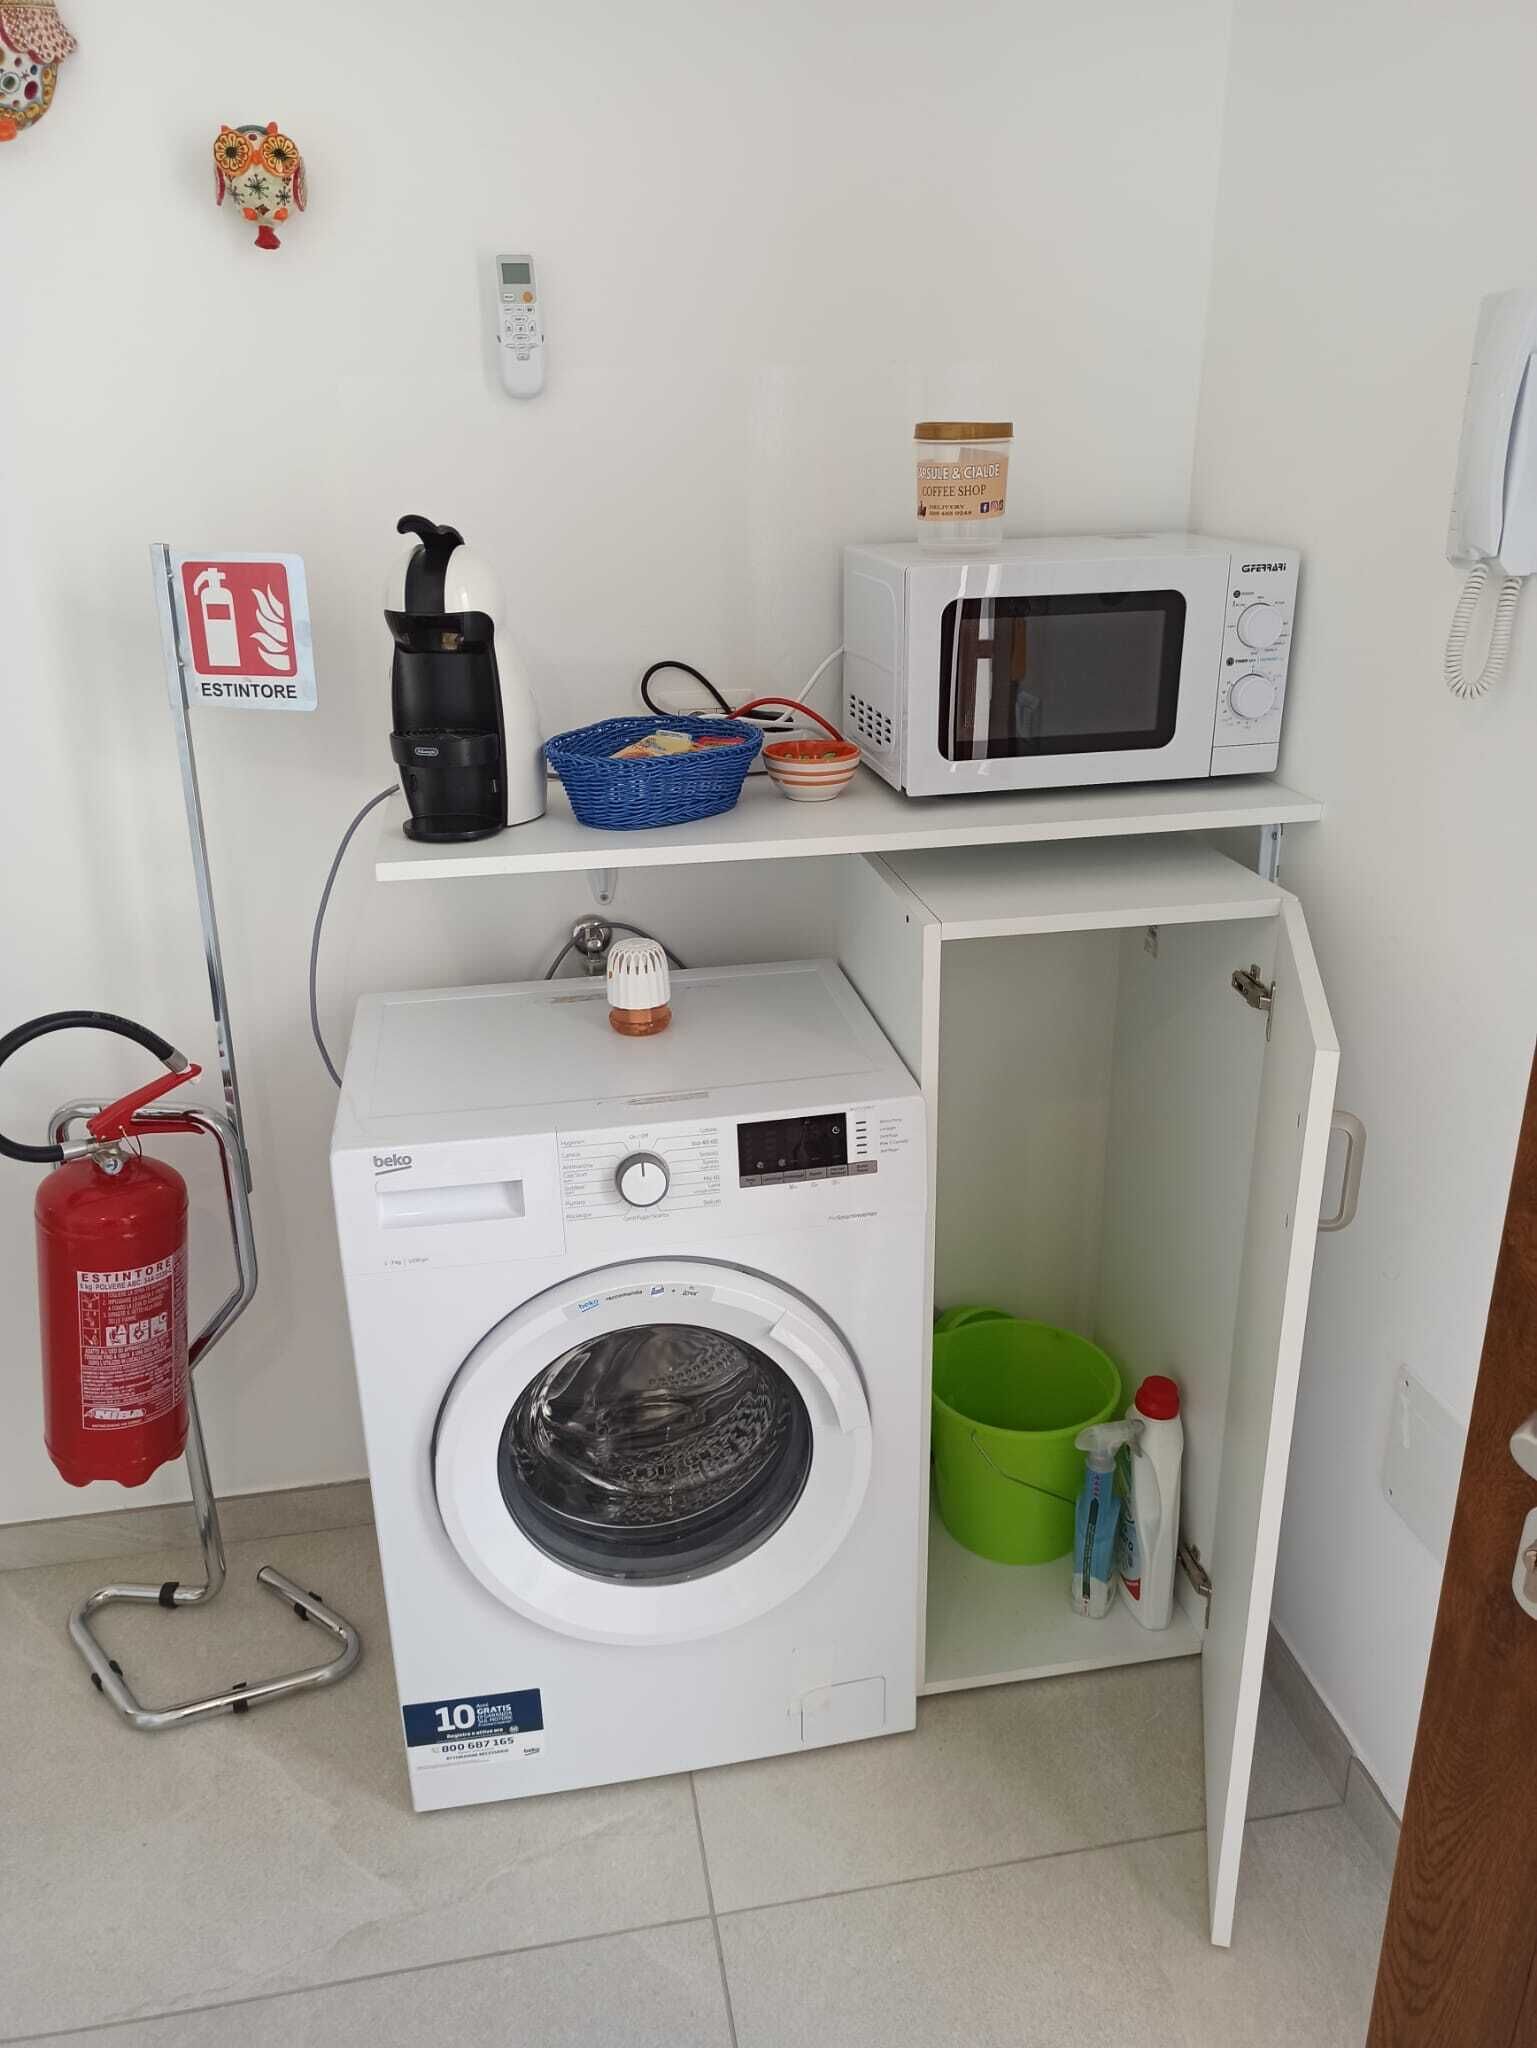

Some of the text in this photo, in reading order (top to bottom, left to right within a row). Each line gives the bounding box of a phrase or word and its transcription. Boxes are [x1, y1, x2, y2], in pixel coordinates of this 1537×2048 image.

[951, 467, 961, 480] &
[963, 463, 1000, 480] CIALDE
[922, 484, 987, 497] COFFEE SHOP
[201, 682, 298, 699] ESTINTORE
[373, 1152, 412, 1168] beko
[81, 1260, 172, 1283] ESTINTORE
[435, 1703, 476, 1732] 10
[476, 1704, 512, 1715] GRATIS
[441, 1736, 514, 1753] 800 687 165
